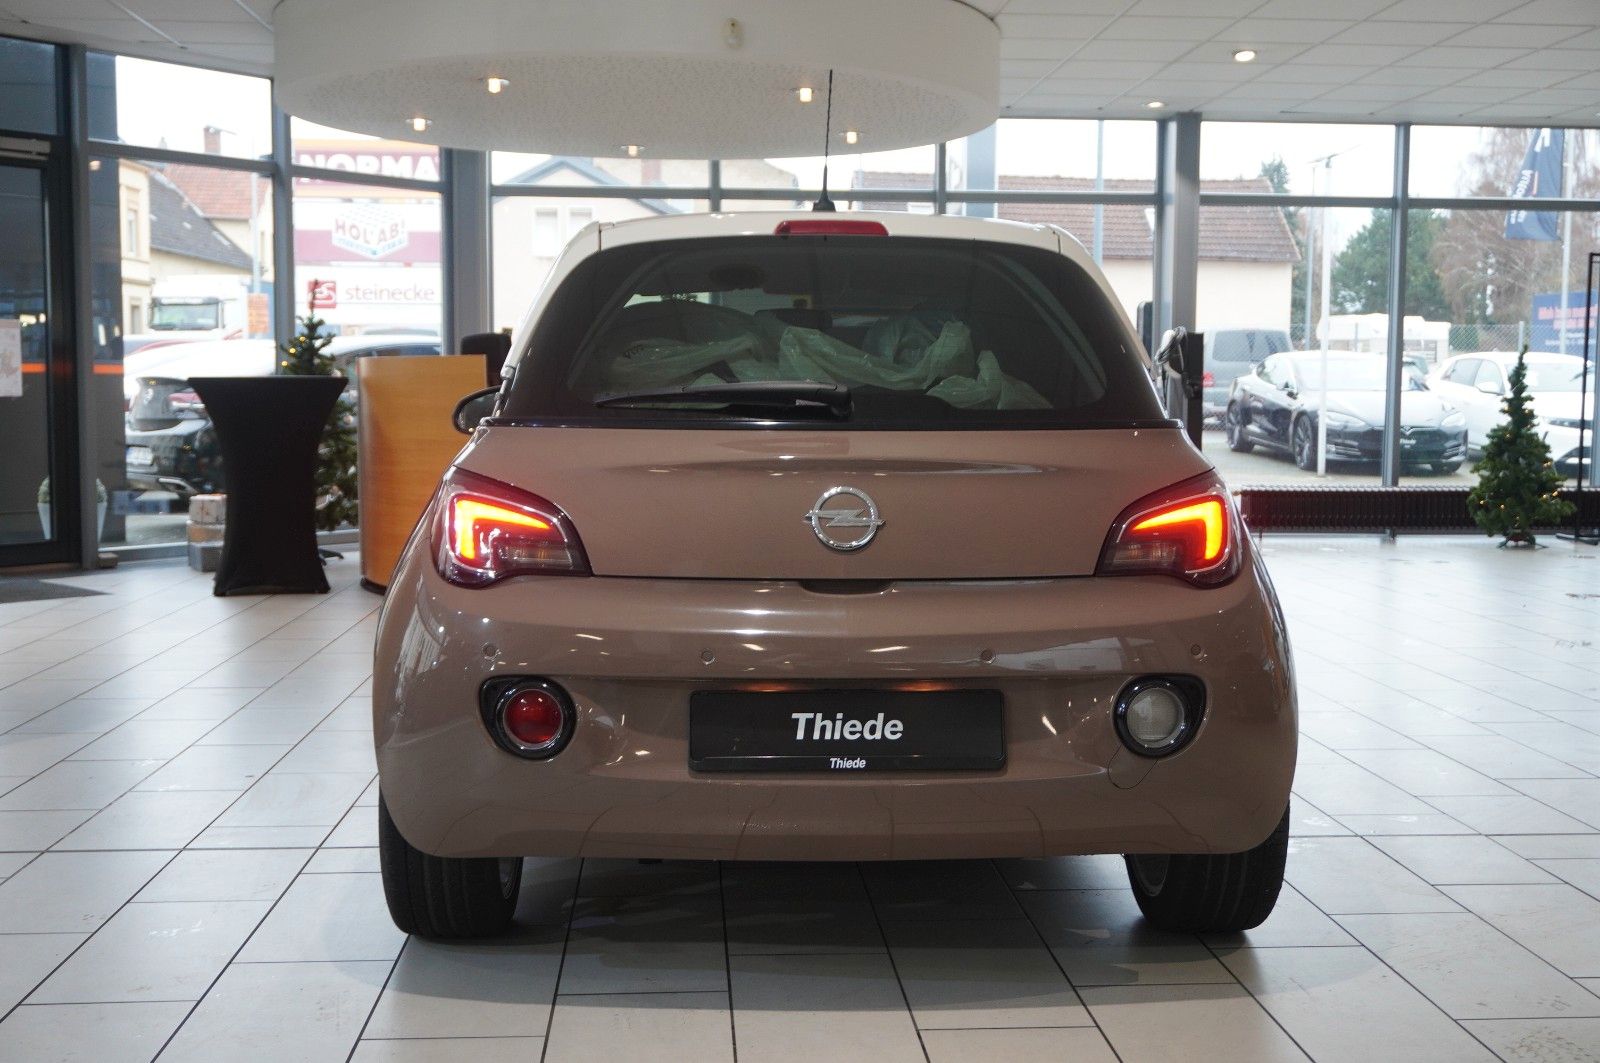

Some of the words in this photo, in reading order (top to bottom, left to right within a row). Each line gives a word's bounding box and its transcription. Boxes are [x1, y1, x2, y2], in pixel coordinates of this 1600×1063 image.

[299, 153, 441, 183] NORMA
[345, 283, 435, 301] steinecke
[791, 712, 904, 740] Thiede
[829, 757, 866, 769] Thiede
